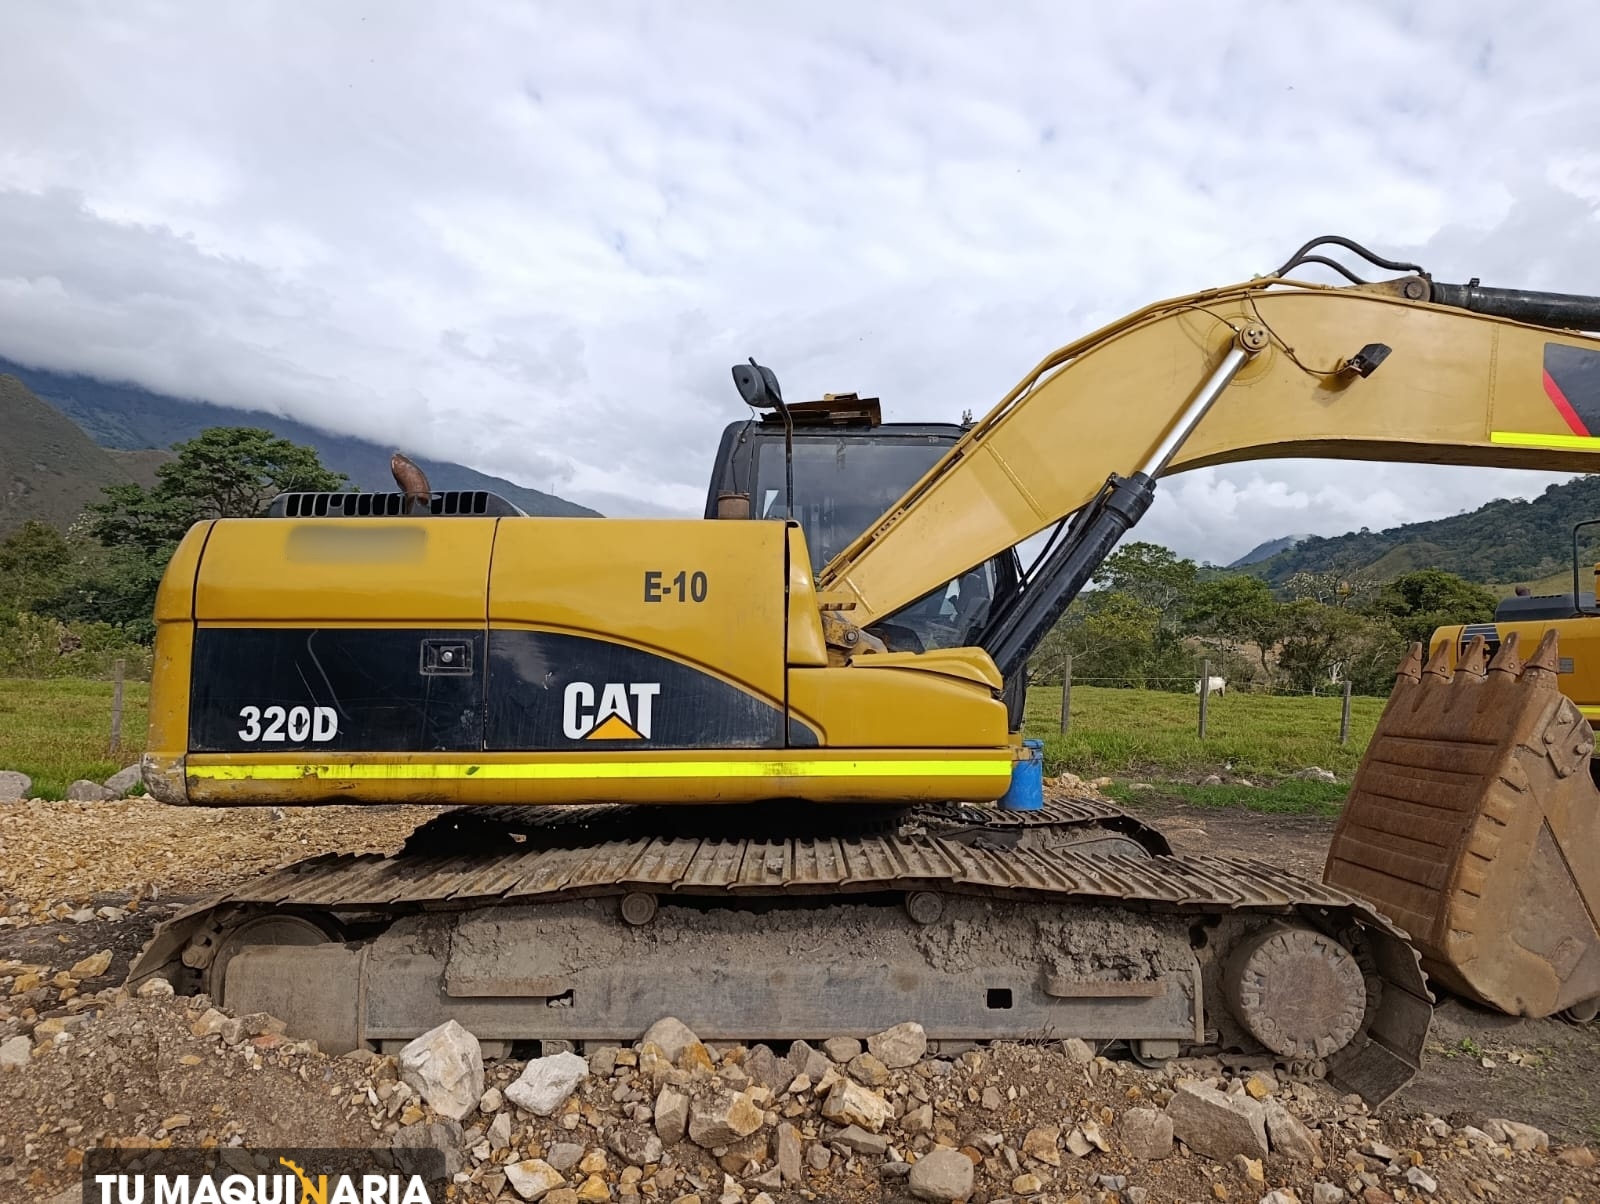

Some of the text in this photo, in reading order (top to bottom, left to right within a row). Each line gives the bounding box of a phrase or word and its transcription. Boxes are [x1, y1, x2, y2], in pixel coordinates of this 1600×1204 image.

[644, 571, 708, 603] E-10
[238, 705, 338, 742] 320D
[563, 681, 660, 740] CAT
